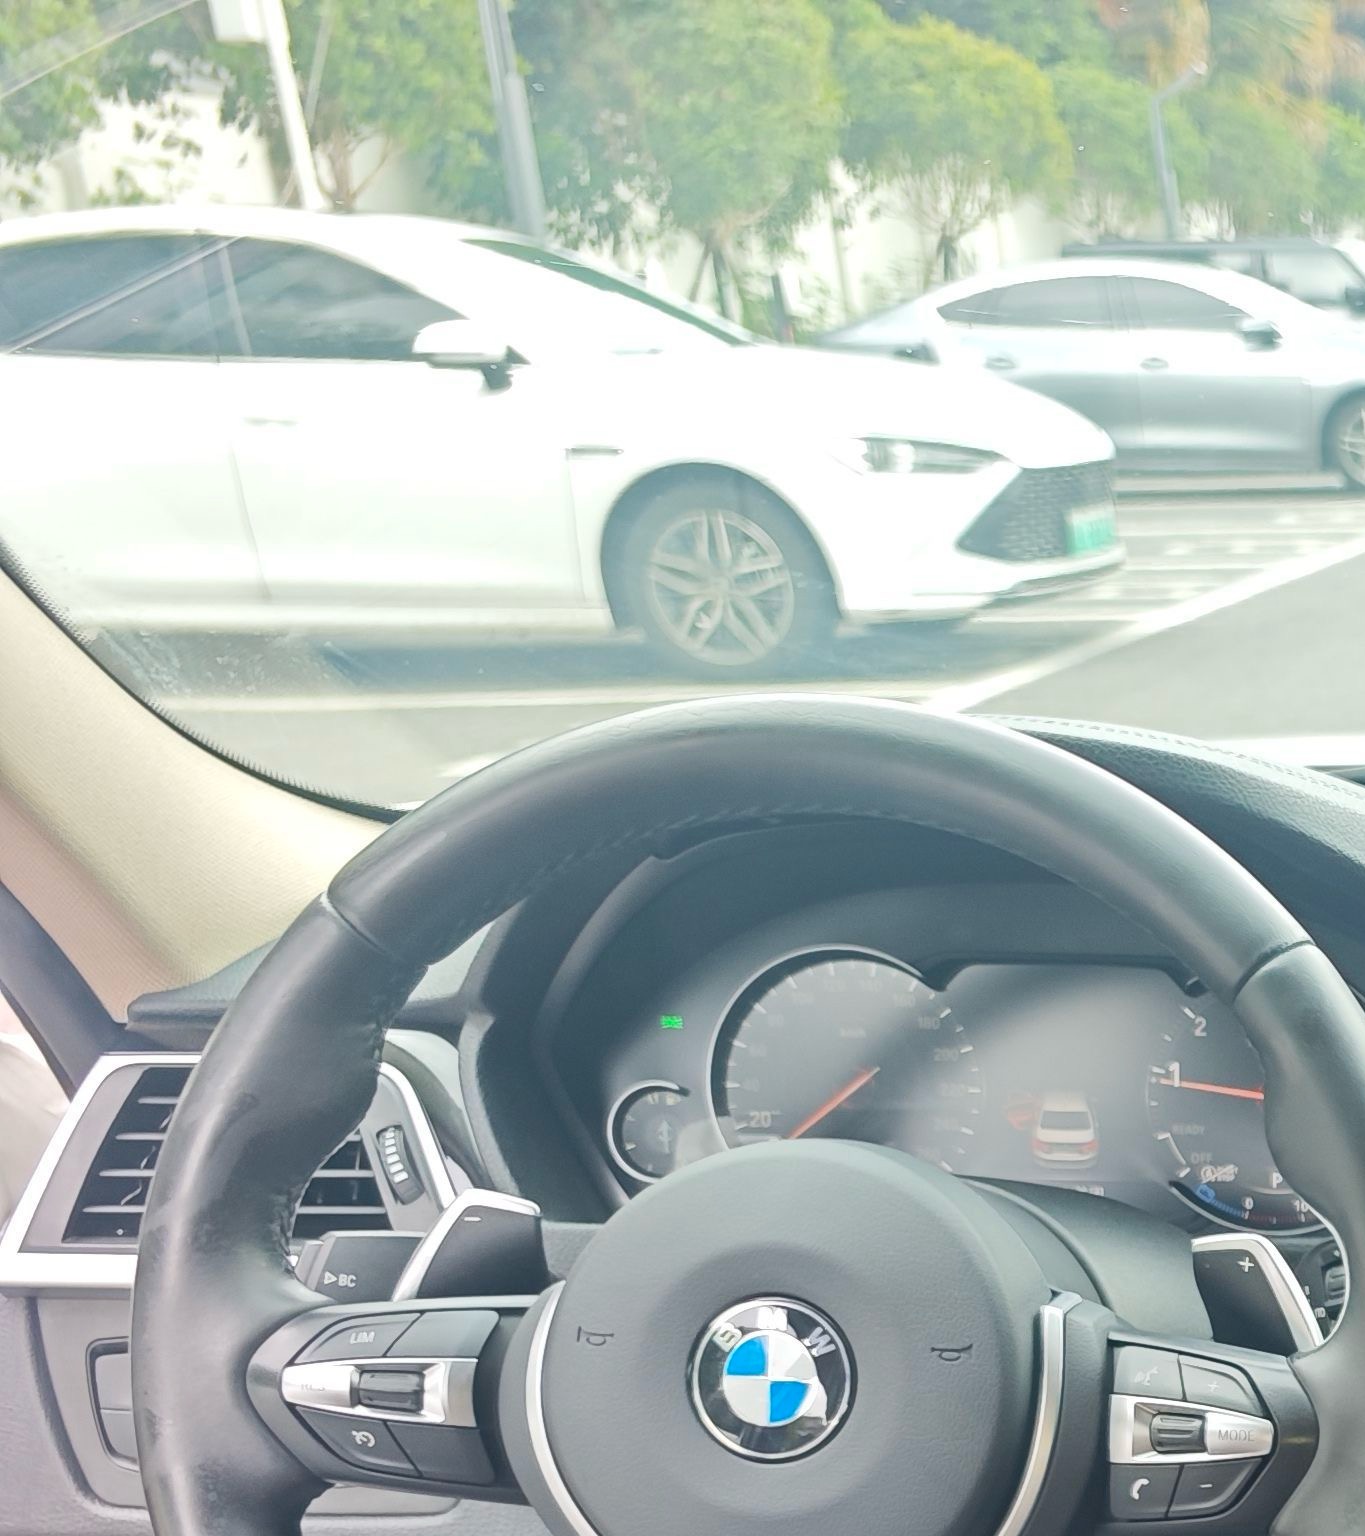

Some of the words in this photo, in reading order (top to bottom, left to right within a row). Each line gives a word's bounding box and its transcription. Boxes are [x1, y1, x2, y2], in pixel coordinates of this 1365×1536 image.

[918, 1016, 941, 1030] 180
[1194, 1015, 1207, 1037] 2
[1169, 1061, 1181, 1088] 1
[749, 1111, 772, 1128] 20
[338, 1274, 356, 1288] BC
[712, 1305, 837, 1358] BMW
[1217, 1429, 1257, 1442] MODE
